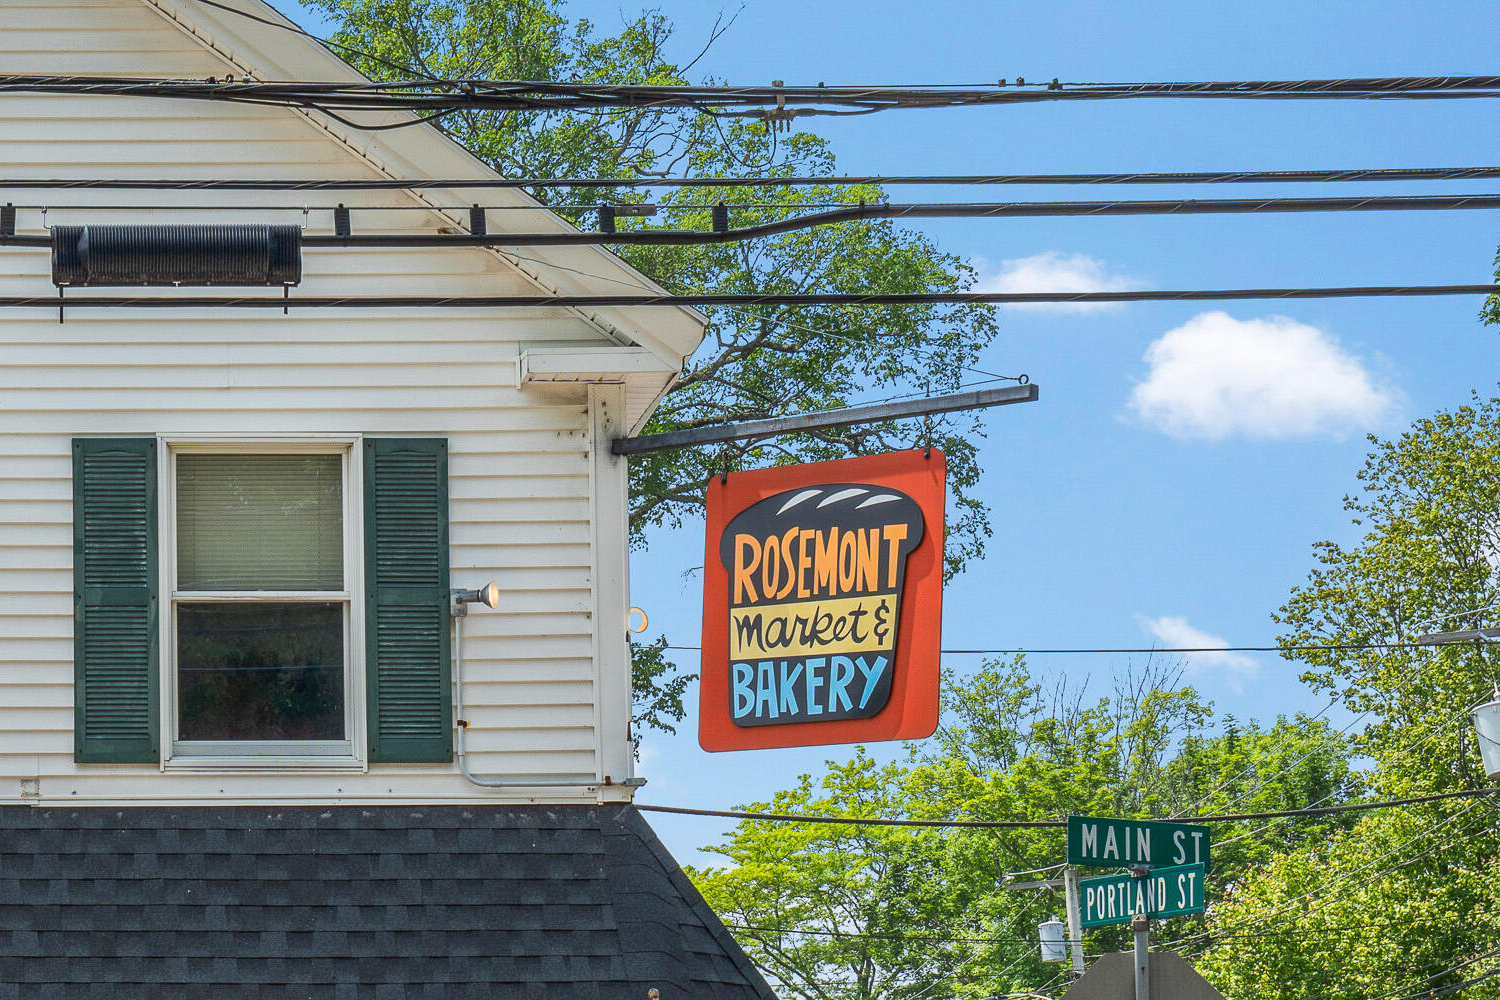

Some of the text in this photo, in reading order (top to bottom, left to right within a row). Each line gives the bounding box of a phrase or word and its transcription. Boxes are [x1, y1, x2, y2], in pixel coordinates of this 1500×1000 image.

[733, 523, 909, 605] ROSEMONT
[873, 599, 891, 646] &
[732, 655, 889, 719] BAKERY
[1081, 823, 1203, 865] MAIN ST
[1086, 872, 1196, 921] PORTLAND ST
